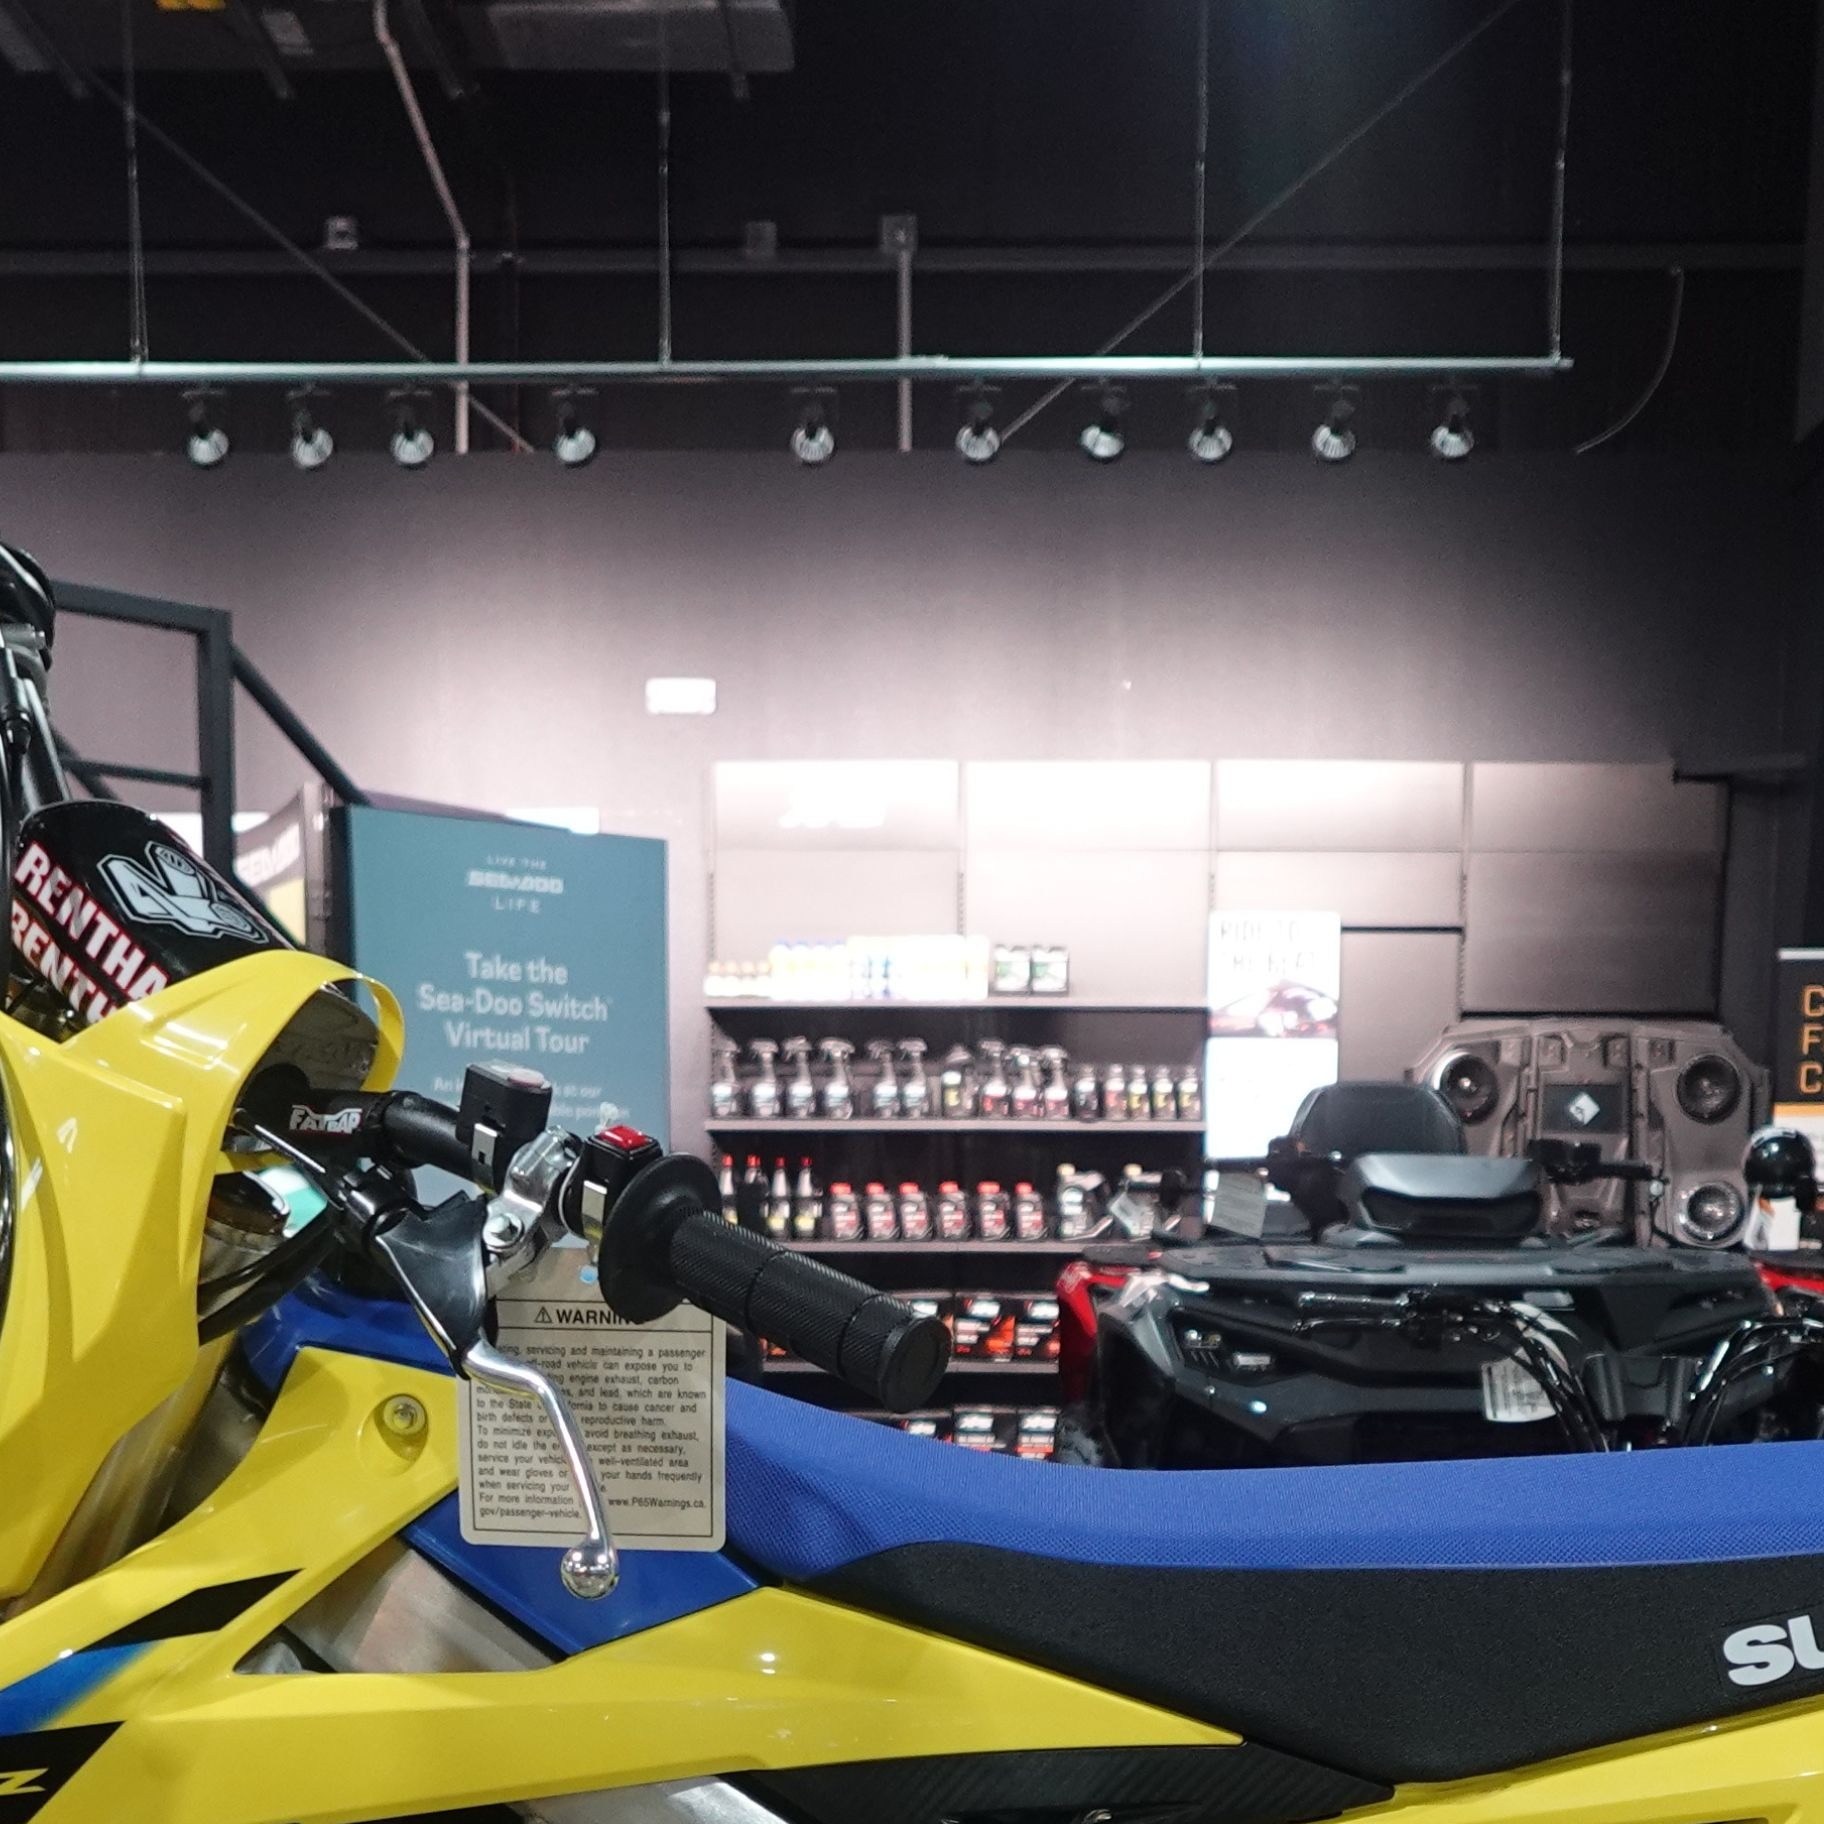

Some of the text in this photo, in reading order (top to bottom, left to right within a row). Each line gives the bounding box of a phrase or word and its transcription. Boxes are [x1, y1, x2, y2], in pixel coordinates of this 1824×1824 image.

[491, 895, 541, 914] LIFE
[14, 842, 168, 1001] RENTHA
[465, 951, 569, 985] Take the
[419, 983, 609, 1022] Sea-Doo Switch
[444, 1021, 590, 1054] Virtual Tour
[570, 1346, 588, 1356] and
[647, 1349, 654, 1357] a
[658, 1349, 706, 1360] passenger
[603, 1362, 620, 1370] can
[624, 1362, 657, 1373] expose
[662, 1364, 680, 1374] you
[684, 1362, 694, 1371] to
[569, 1374, 599, 1386] engine
[647, 1375, 680, 1386] carbon
[578, 1387, 595, 1398] and
[626, 1388, 653, 1399] which
[657, 1390, 673, 1400] are
[677, 1388, 707, 1400] known
[477, 1399, 486, 1409] to
[490, 1399, 505, 1409] the
[508, 1399, 532, 1410] State
[598, 1401, 608, 1411] to
[612, 1403, 640, 1412] cause
[644, 1403, 675, 1413] cancer
[679, 1403, 698, 1414] and
[477, 1411, 497, 1422] birth
[502, 1412, 534, 1423] defects
[580, 1414, 636, 1427] reproductive
[477, 1425, 489, 1435] To
[583, 1429, 609, 1440] avoid
[613, 1429, 656, 1442] breathing
[661, 1430, 700, 1442] exhaust,
[477, 1440, 489, 1450] do
[493, 1440, 508, 1451] not
[512, 1440, 529, 1451] idle
[532, 1440, 548, 1451] the
[621, 1444, 633, 1453] as
[478, 1453, 510, 1464] service
[513, 1455, 534, 1466] your
[668, 1458, 690, 1468] area
[478, 1466, 704, 1484] and wear gloves or your hands frequently
[478, 1479, 570, 1494] when servicing your
[479, 1492, 494, 1502] For
[498, 1494, 521, 1503] more
[524, 1494, 574, 1505] information
